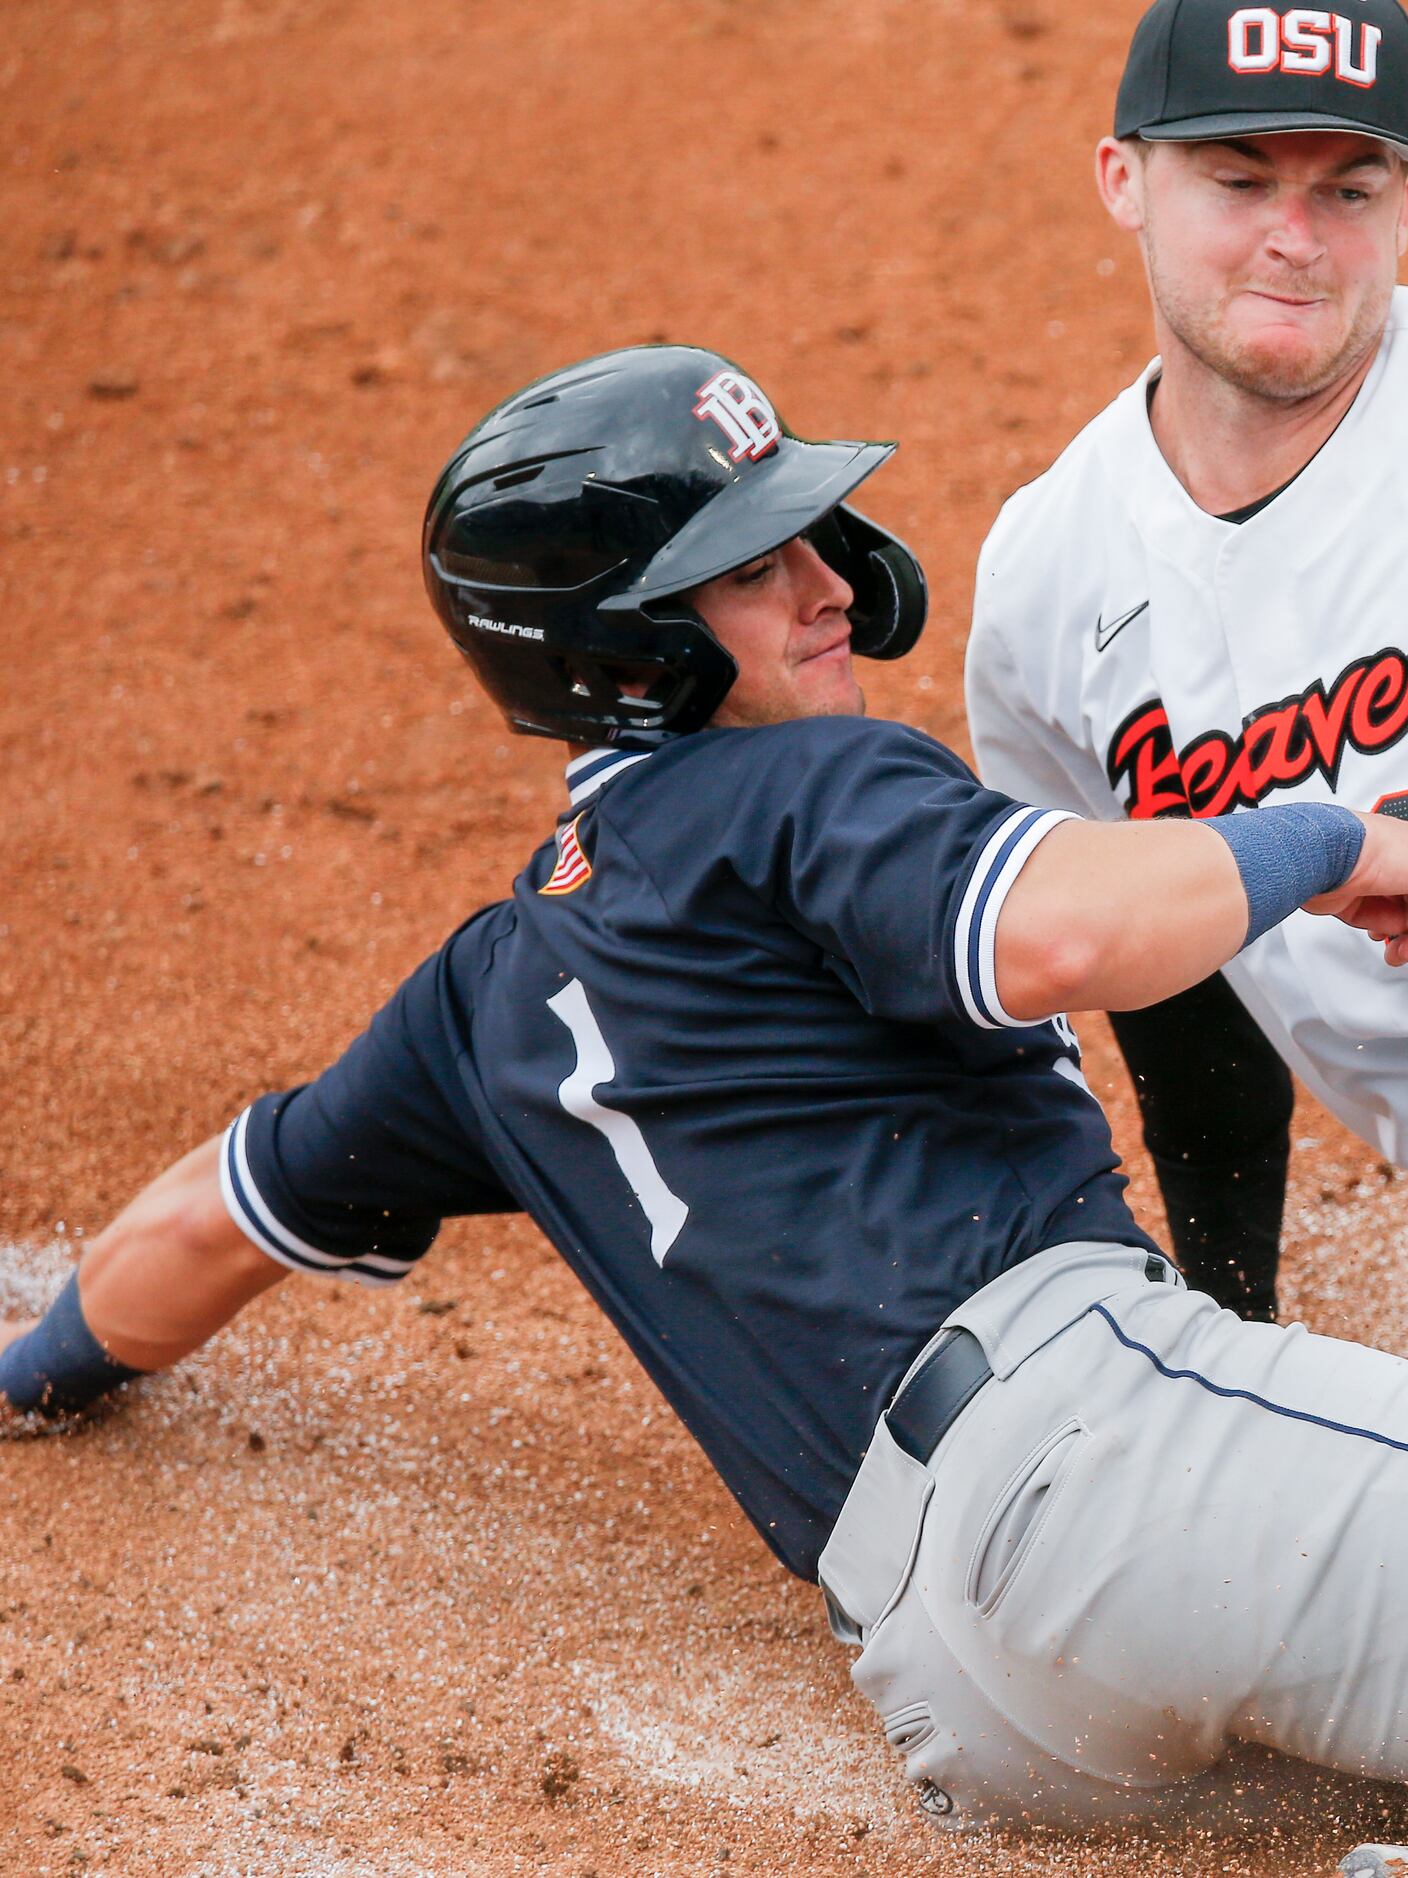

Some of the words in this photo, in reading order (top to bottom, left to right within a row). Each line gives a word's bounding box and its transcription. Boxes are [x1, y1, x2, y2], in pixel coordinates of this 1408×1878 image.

[1228, 7, 1382, 89] OSU
[468, 614, 544, 640] RAWLINGS
[546, 977, 689, 1269] 1
